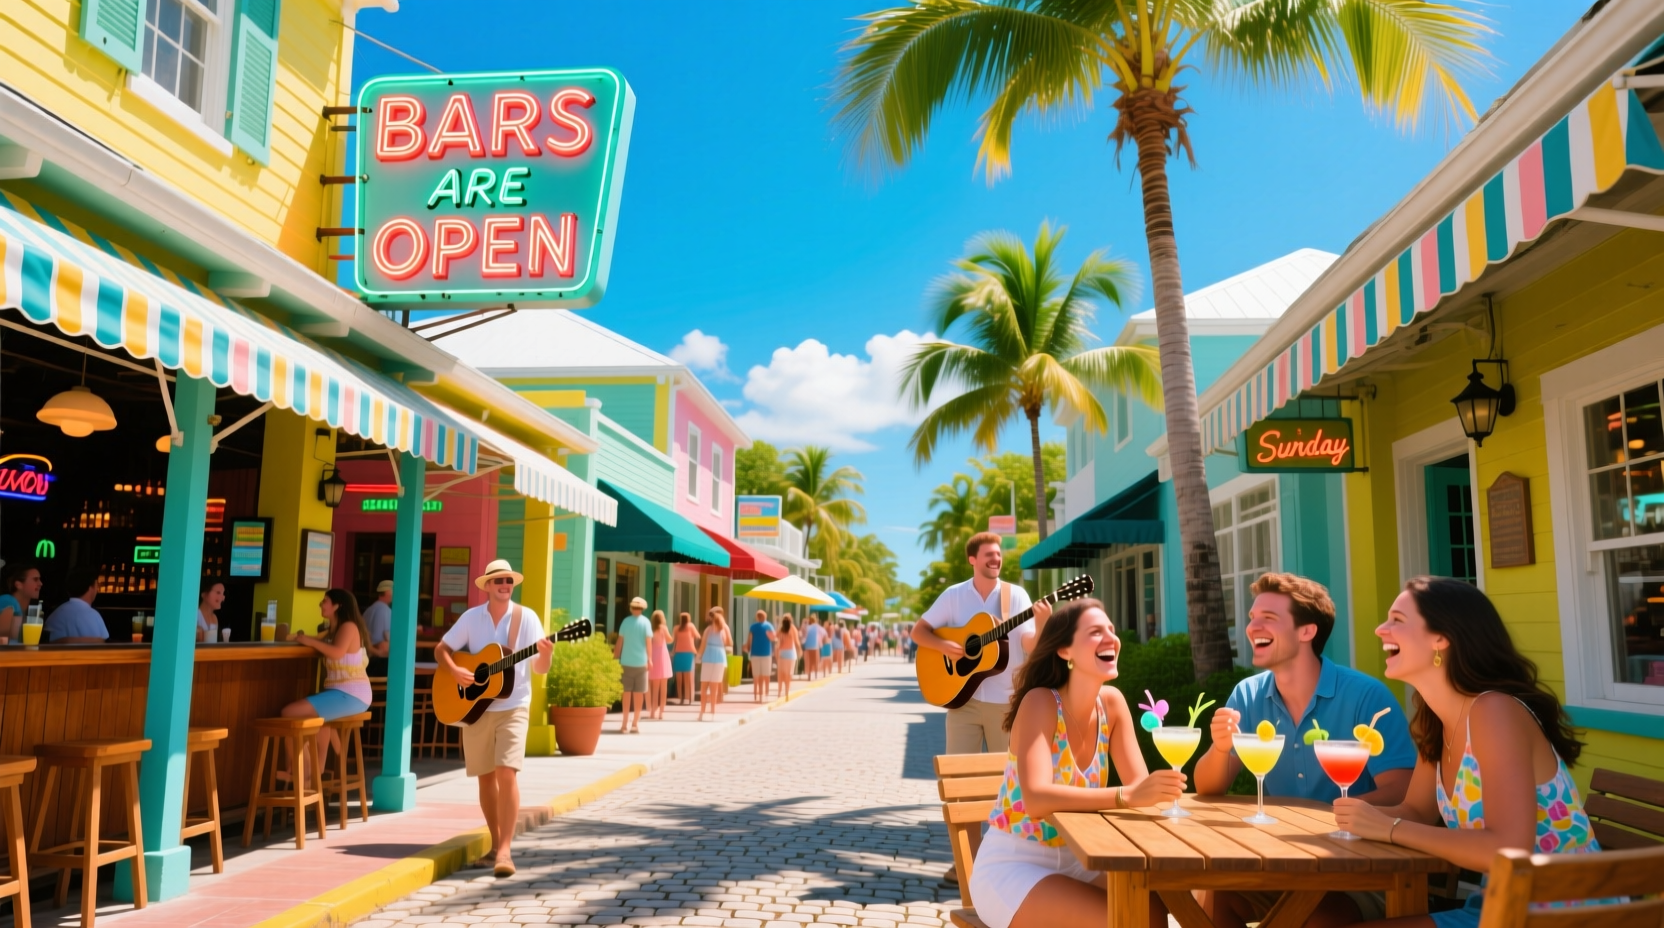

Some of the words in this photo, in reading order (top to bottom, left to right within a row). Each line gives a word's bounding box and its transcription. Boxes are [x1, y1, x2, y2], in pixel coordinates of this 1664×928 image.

[375, 88, 596, 161] BARS
[427, 167, 531, 209] ARE
[372, 213, 578, 280] OPEN
[1257, 428, 1350, 466] Sunday
